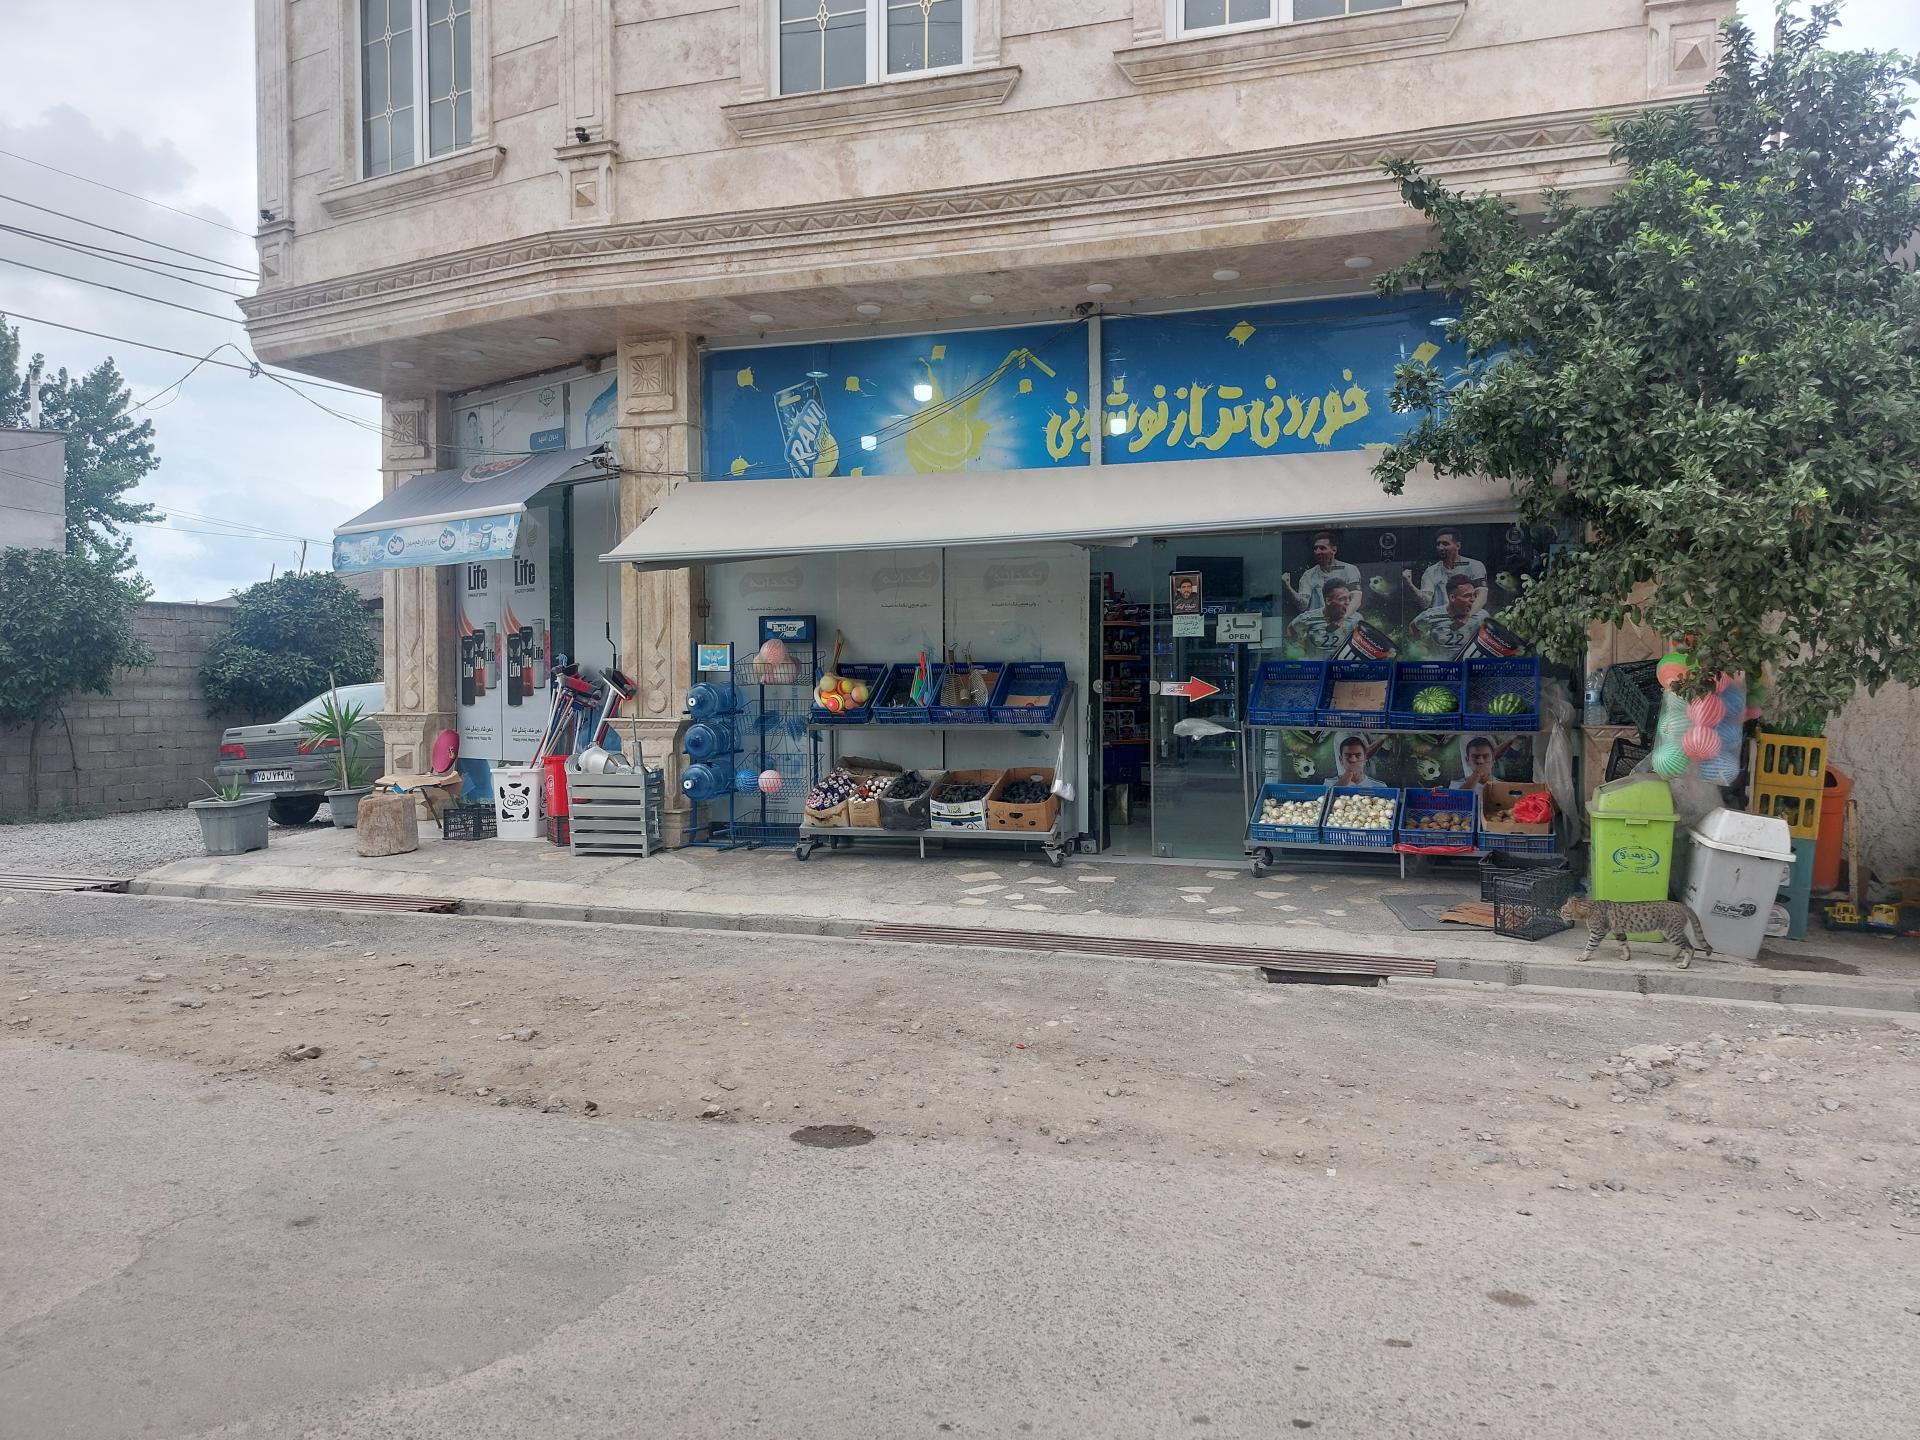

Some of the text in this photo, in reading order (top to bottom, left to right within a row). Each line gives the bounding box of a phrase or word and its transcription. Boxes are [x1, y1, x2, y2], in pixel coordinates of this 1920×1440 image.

[1250, 368, 1370, 447] خوردنی
[791, 403, 824, 476] RANI
[468, 565, 488, 591] Life
[515, 560, 536, 587] Life
[1223, 617, 1257, 633] باز
[1322, 635, 1340, 648] 22
[1445, 633, 1464, 646] 22
[509, 661, 521, 677] Life
[507, 798, 525, 807] میهن
